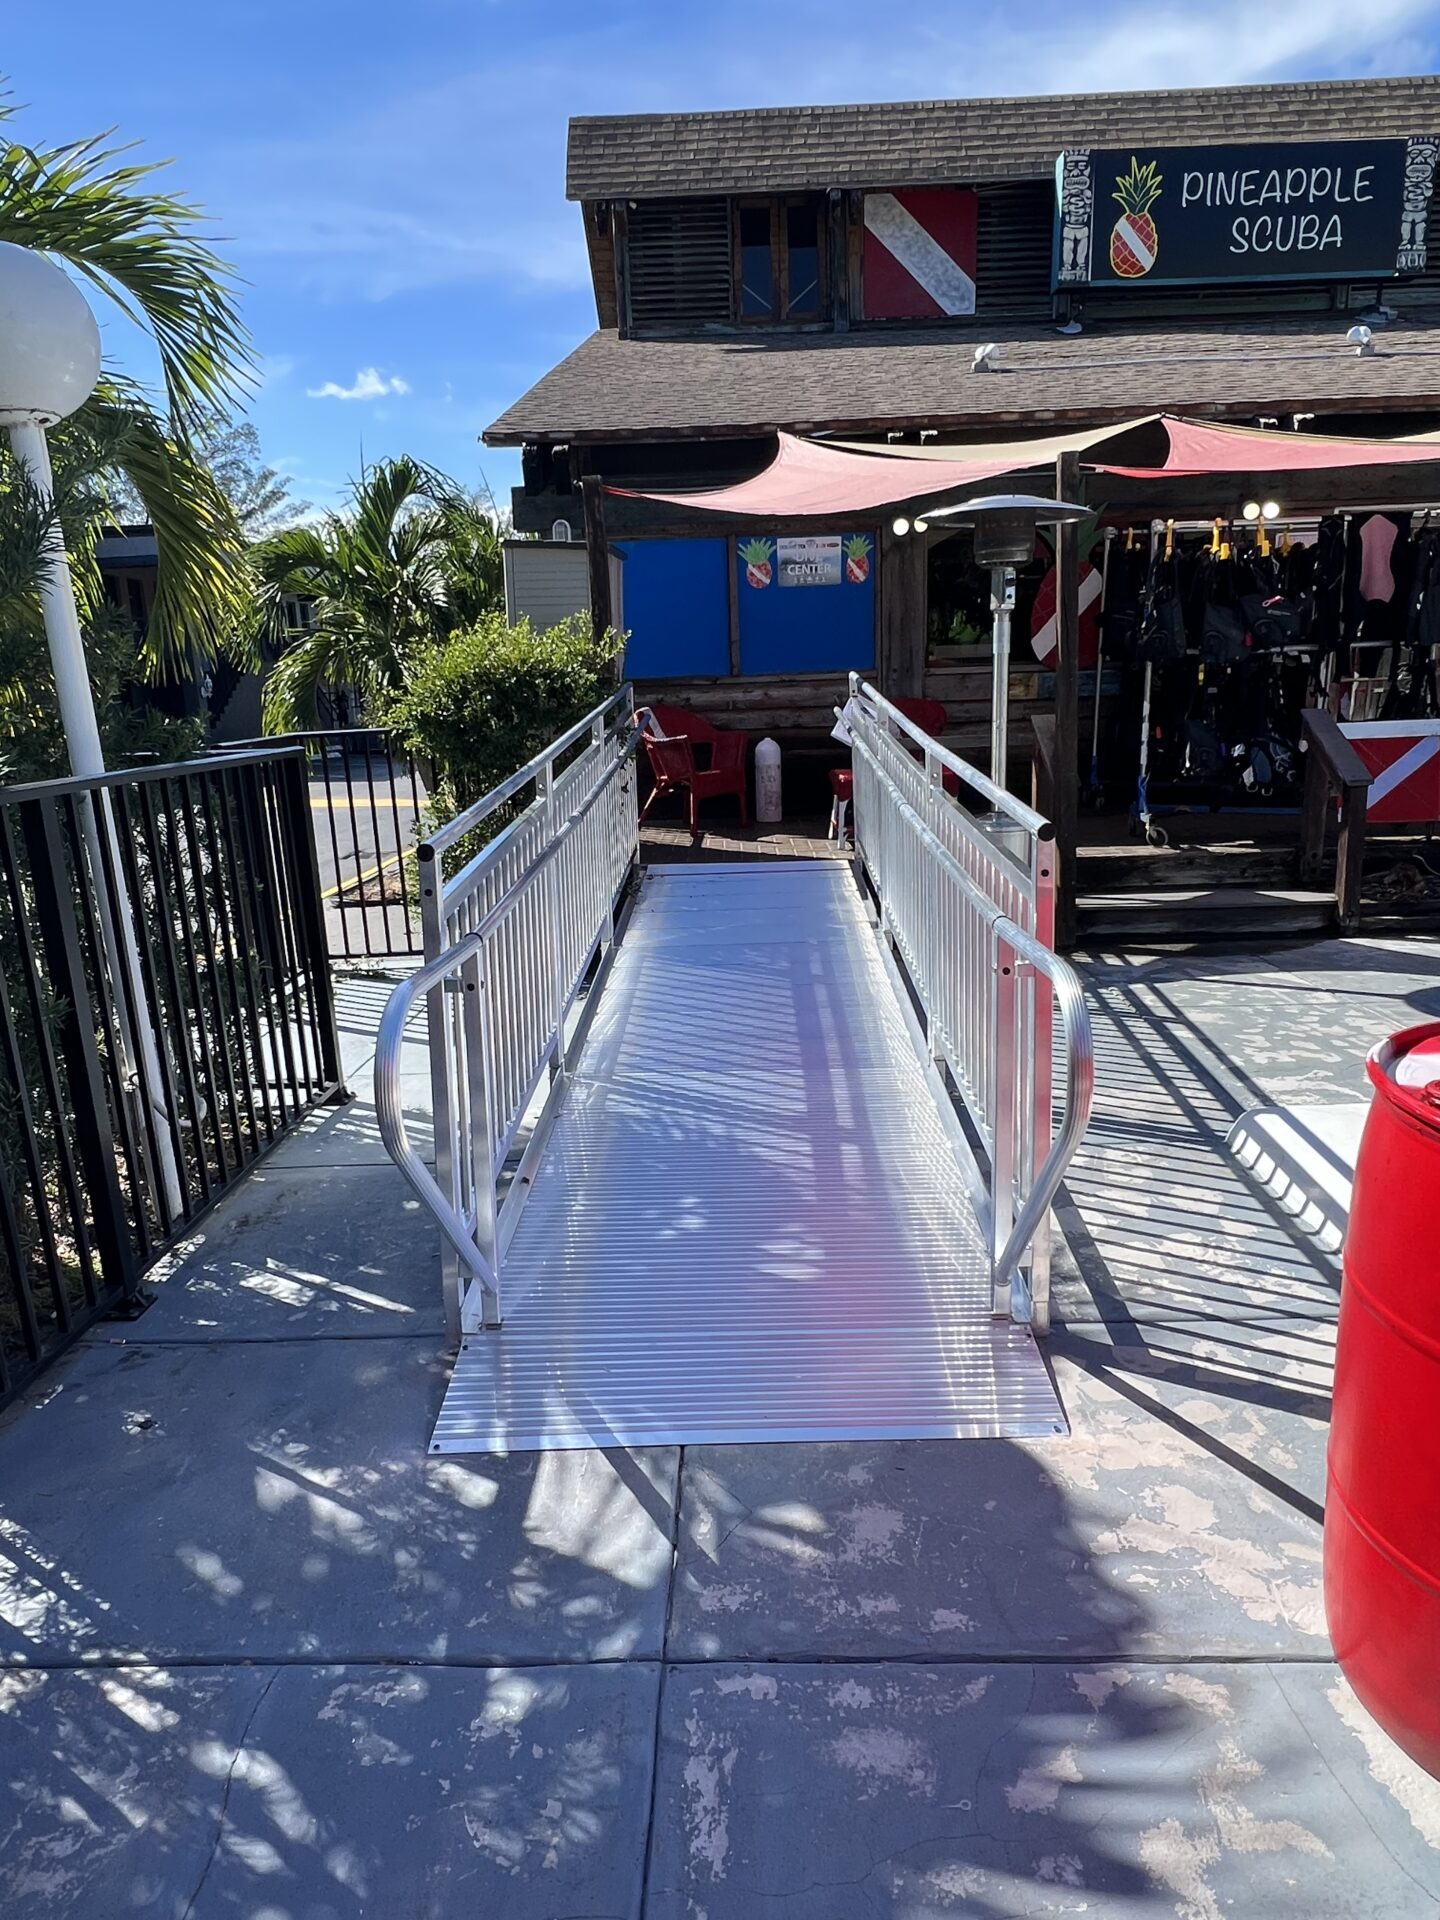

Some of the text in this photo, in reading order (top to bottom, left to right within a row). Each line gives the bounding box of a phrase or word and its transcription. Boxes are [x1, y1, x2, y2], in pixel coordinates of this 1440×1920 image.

[1181, 165, 1375, 207] PINEAPPLE
[1229, 214, 1343, 253] SCUBA
[787, 563, 832, 576] CENTER
